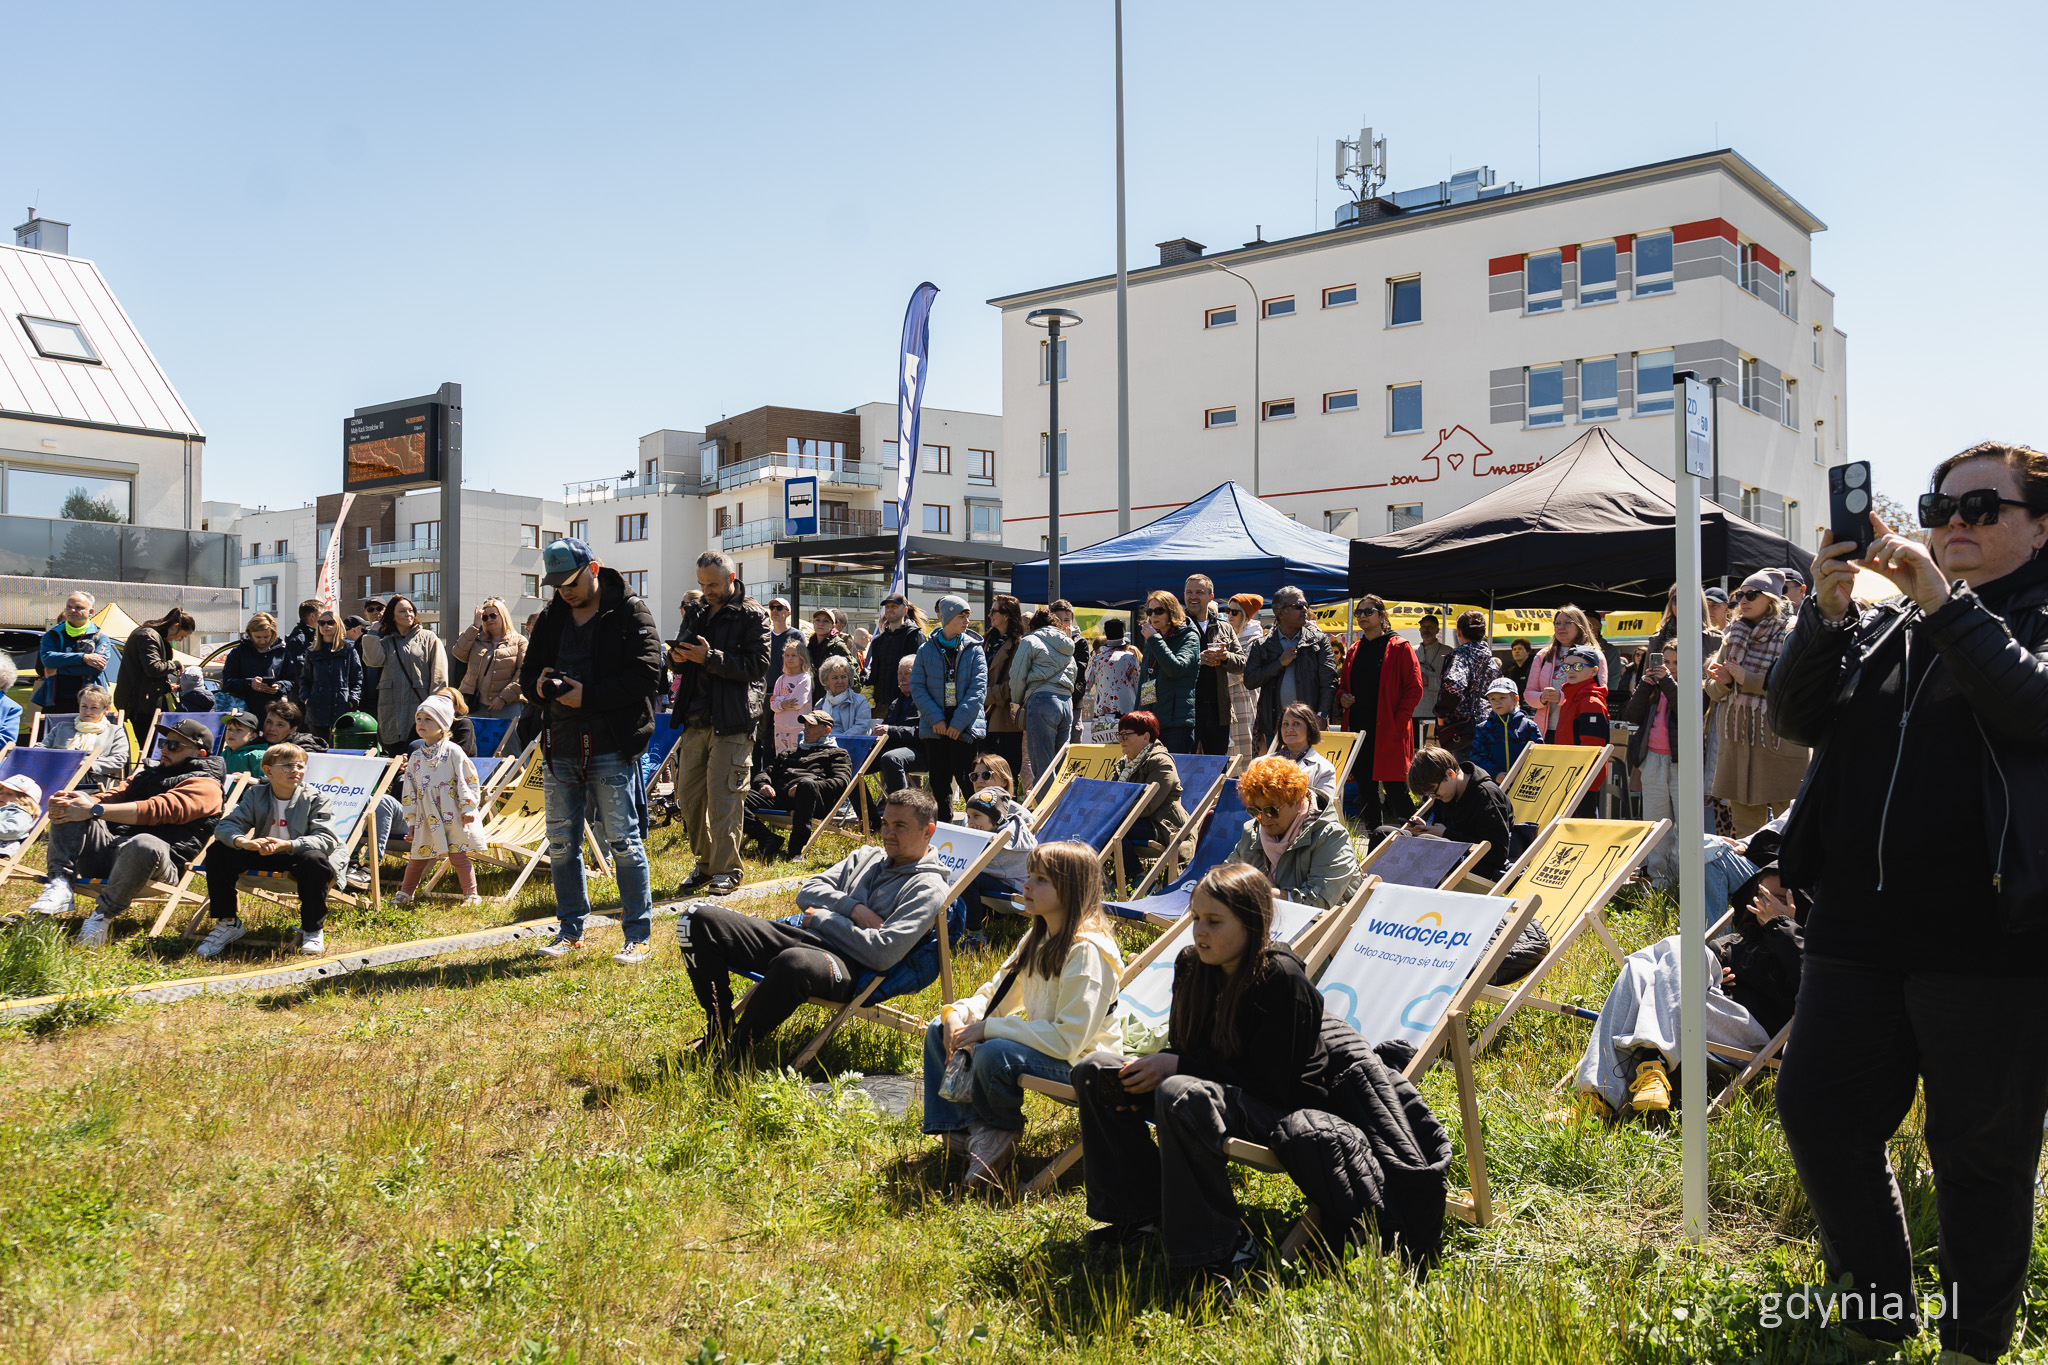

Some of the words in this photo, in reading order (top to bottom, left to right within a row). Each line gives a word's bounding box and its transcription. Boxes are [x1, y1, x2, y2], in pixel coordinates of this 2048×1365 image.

[1687, 398, 1698, 415] ZD
[1390, 475, 1420, 486] DOM
[1314, 609, 1337, 620] TÓW
[1617, 619, 1643, 630] BYTÓW
[309, 783, 364, 797] kacje.pl
[1368, 919, 1472, 949] wakacje.pl
[1354, 943, 1378, 959] Urlop
[1378, 950, 1417, 965] zaczyna
[1417, 957, 1431, 968] się
[1432, 957, 1457, 971] tutaj
